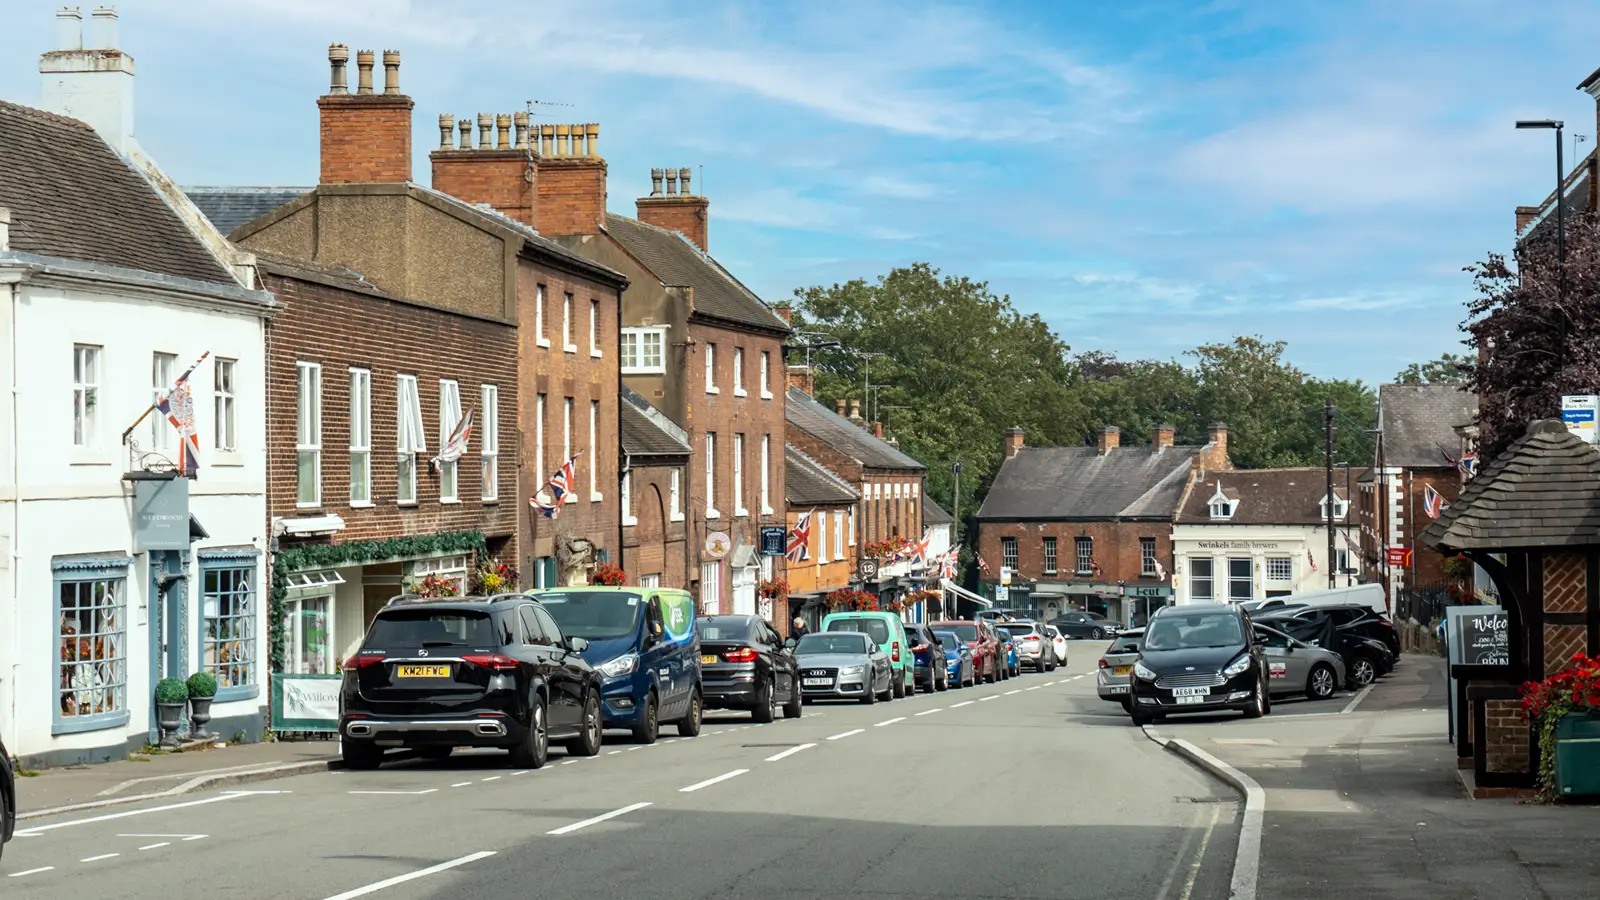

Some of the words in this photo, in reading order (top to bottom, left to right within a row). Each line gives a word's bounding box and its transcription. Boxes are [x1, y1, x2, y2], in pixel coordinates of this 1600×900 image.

[1198, 541, 1229, 549] Swinkels
[1230, 541, 1251, 550] family
[1252, 541, 1277, 549] brewers
[863, 564, 874, 573] 12
[403, 666, 424, 676] KM21
[425, 666, 444, 676] FWC
[1194, 687, 1208, 695] WHN
[301, 692, 339, 702] Willow
